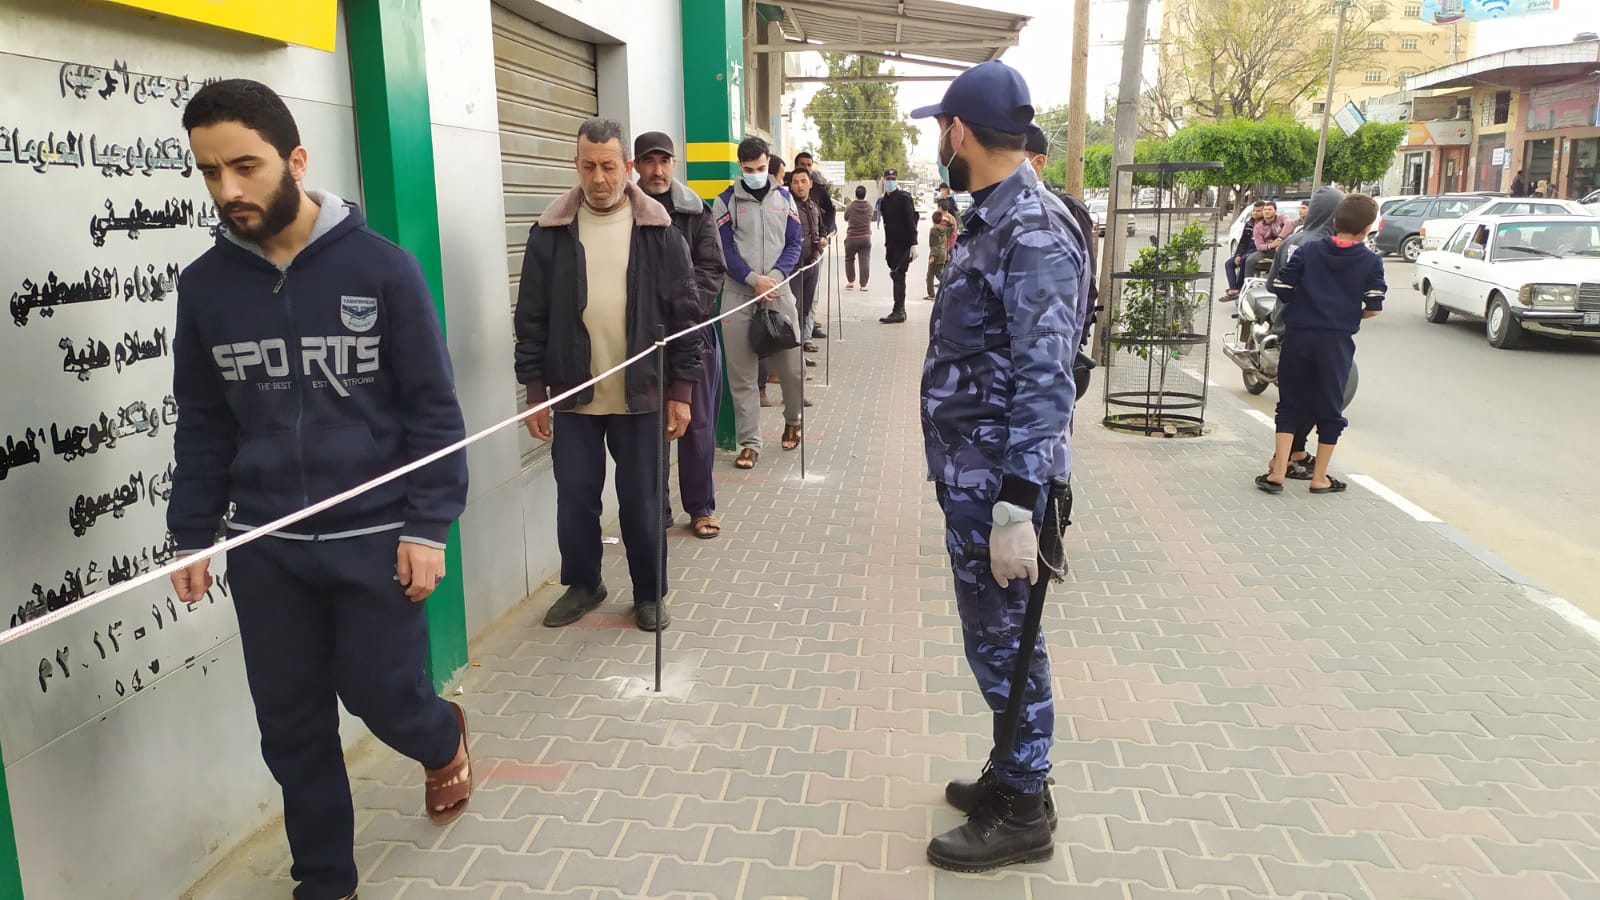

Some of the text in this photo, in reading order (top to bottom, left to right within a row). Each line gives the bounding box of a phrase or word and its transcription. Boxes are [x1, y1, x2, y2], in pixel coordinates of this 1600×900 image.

[89, 131, 194, 178] وتكنولوجيا
[90, 197, 194, 247] الفلسطيني
[9, 266, 119, 327] الفلسطيني
[58, 336, 110, 382] هنية
[50, 400, 160, 463] وتكنولوجيا
